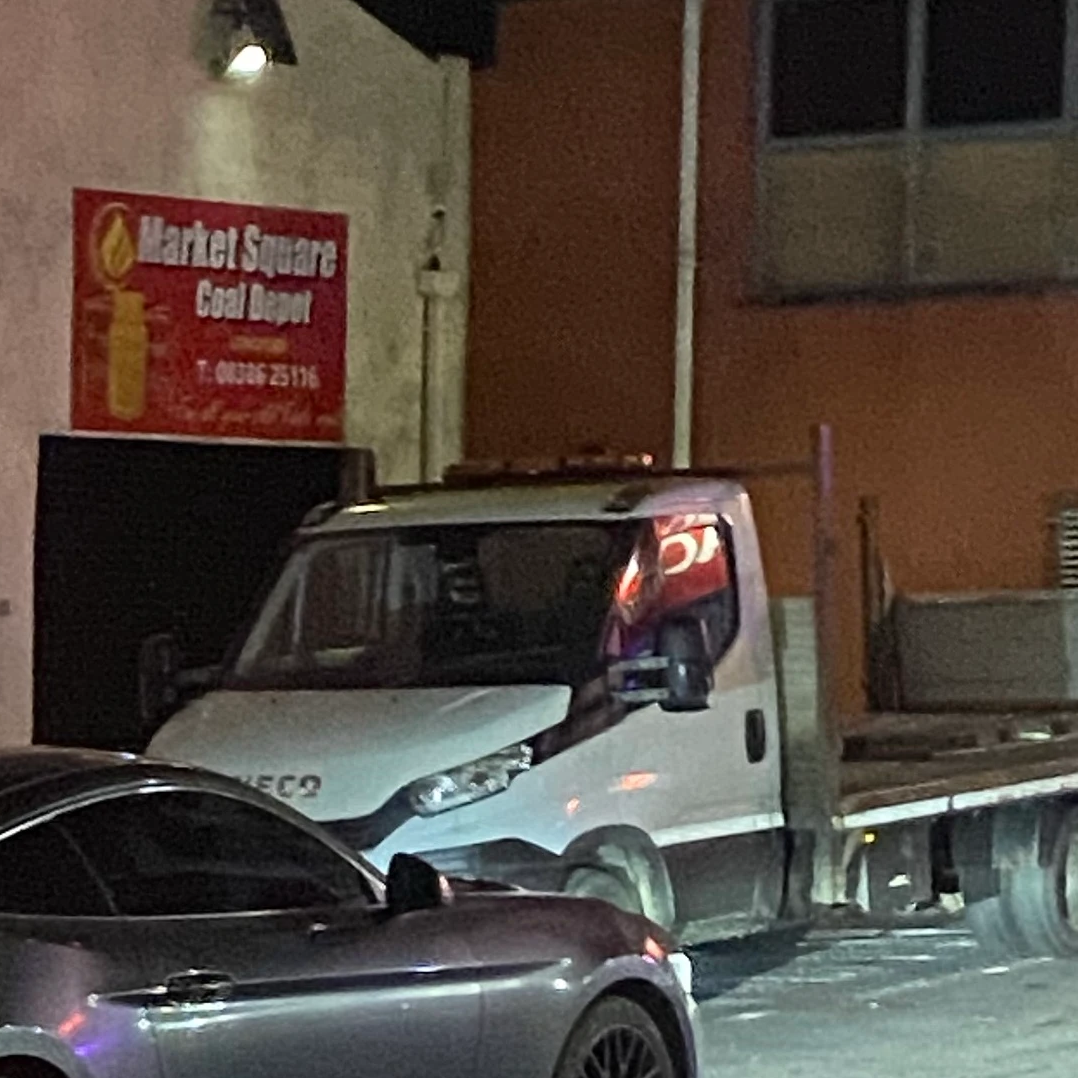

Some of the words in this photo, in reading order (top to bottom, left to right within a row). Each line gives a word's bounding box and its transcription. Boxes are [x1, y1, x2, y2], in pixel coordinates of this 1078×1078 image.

[138, 216, 237, 269] Market
[242, 224, 337, 278] Square
[196, 279, 246, 319] Coal
